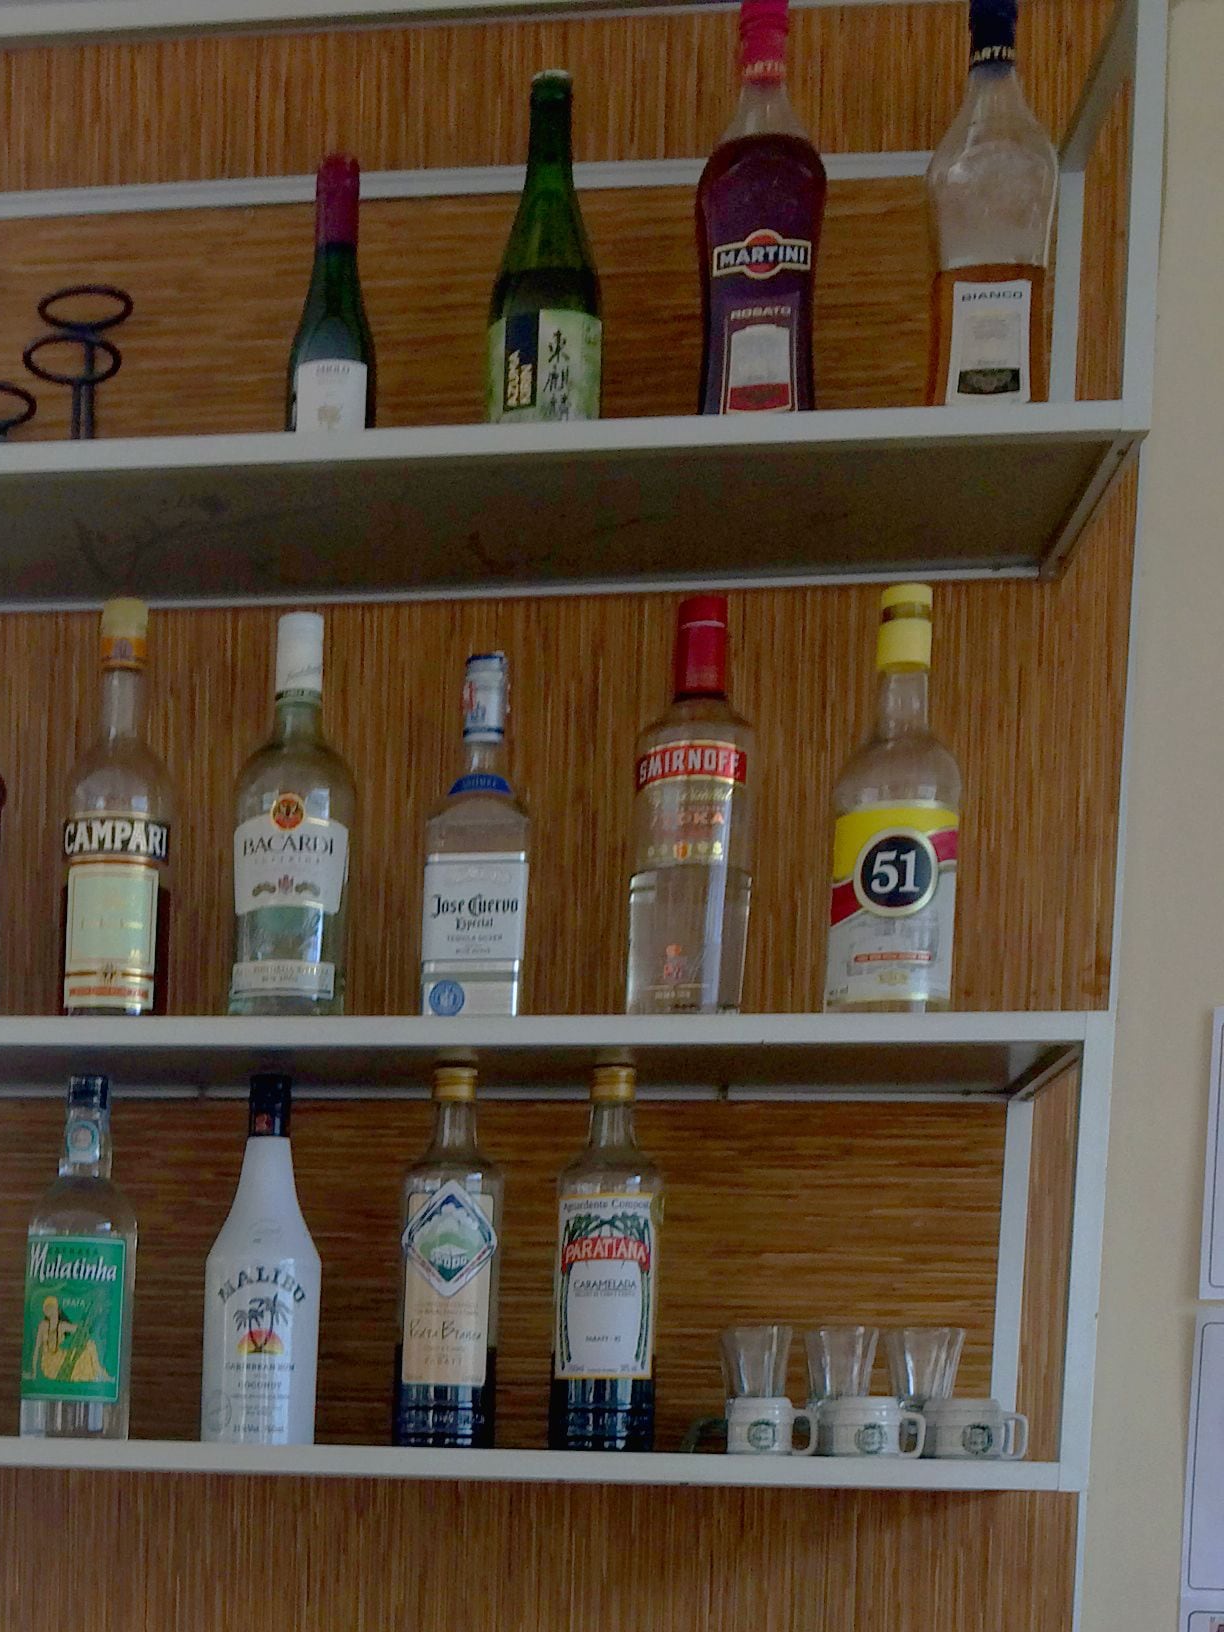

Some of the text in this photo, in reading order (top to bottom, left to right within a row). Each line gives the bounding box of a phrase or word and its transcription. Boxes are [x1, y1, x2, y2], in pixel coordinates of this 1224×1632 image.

[719, 246, 805, 268] MARTINI
[961, 290, 1023, 302] BIANCO
[639, 748, 740, 785] SMIRNOFF
[64, 818, 168, 858] CAMPARI
[243, 833, 334, 857] BACARDI
[870, 850, 921, 894] 51
[431, 893, 519, 920] Jose Cuervo
[30, 1240, 117, 1283] Mulatinha
[565, 1237, 647, 1265] PARATIANA
[218, 1265, 306, 1307] MALIBU
[573, 1278, 637, 1291] CARAMELADA
